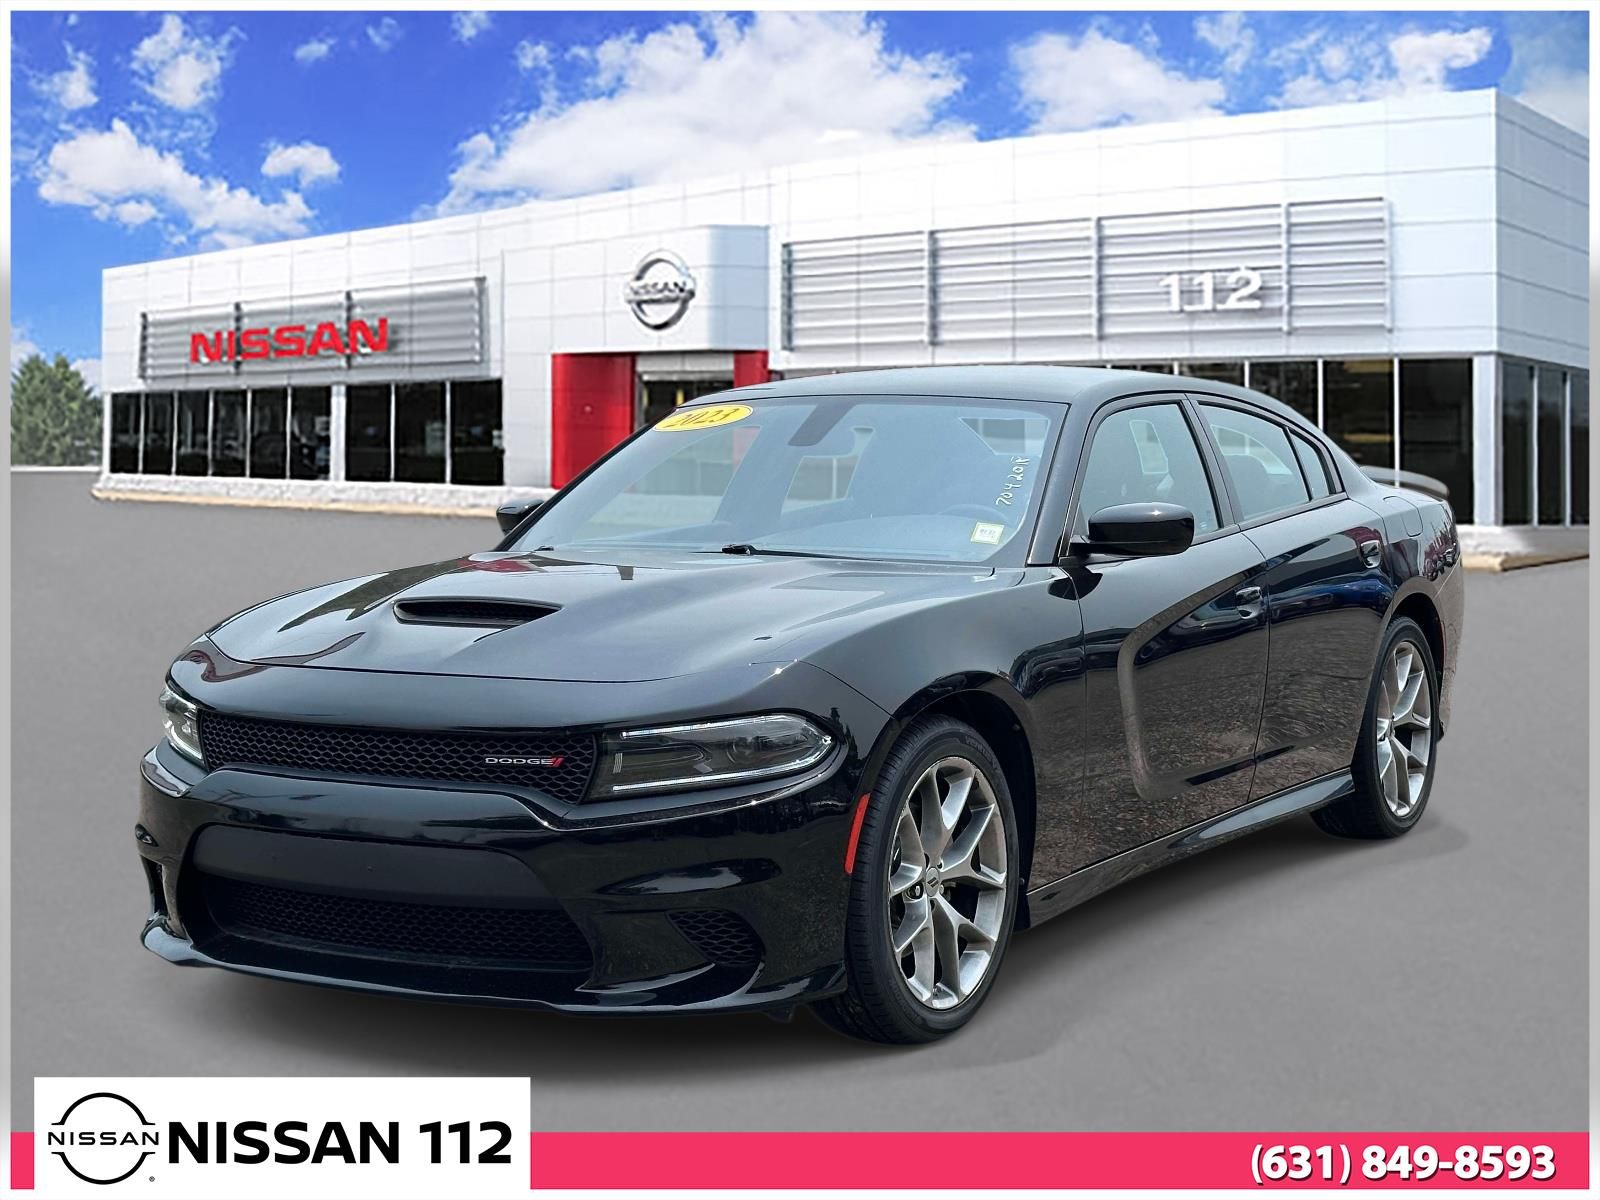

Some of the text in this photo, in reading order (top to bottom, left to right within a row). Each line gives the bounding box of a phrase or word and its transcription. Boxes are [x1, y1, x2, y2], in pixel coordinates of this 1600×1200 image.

[624, 280, 695, 300] NISSAN
[1158, 266, 1262, 311] 112
[189, 317, 389, 363] NISSAN
[660, 407, 742, 429] 2023
[484, 756, 554, 766] DODGE
